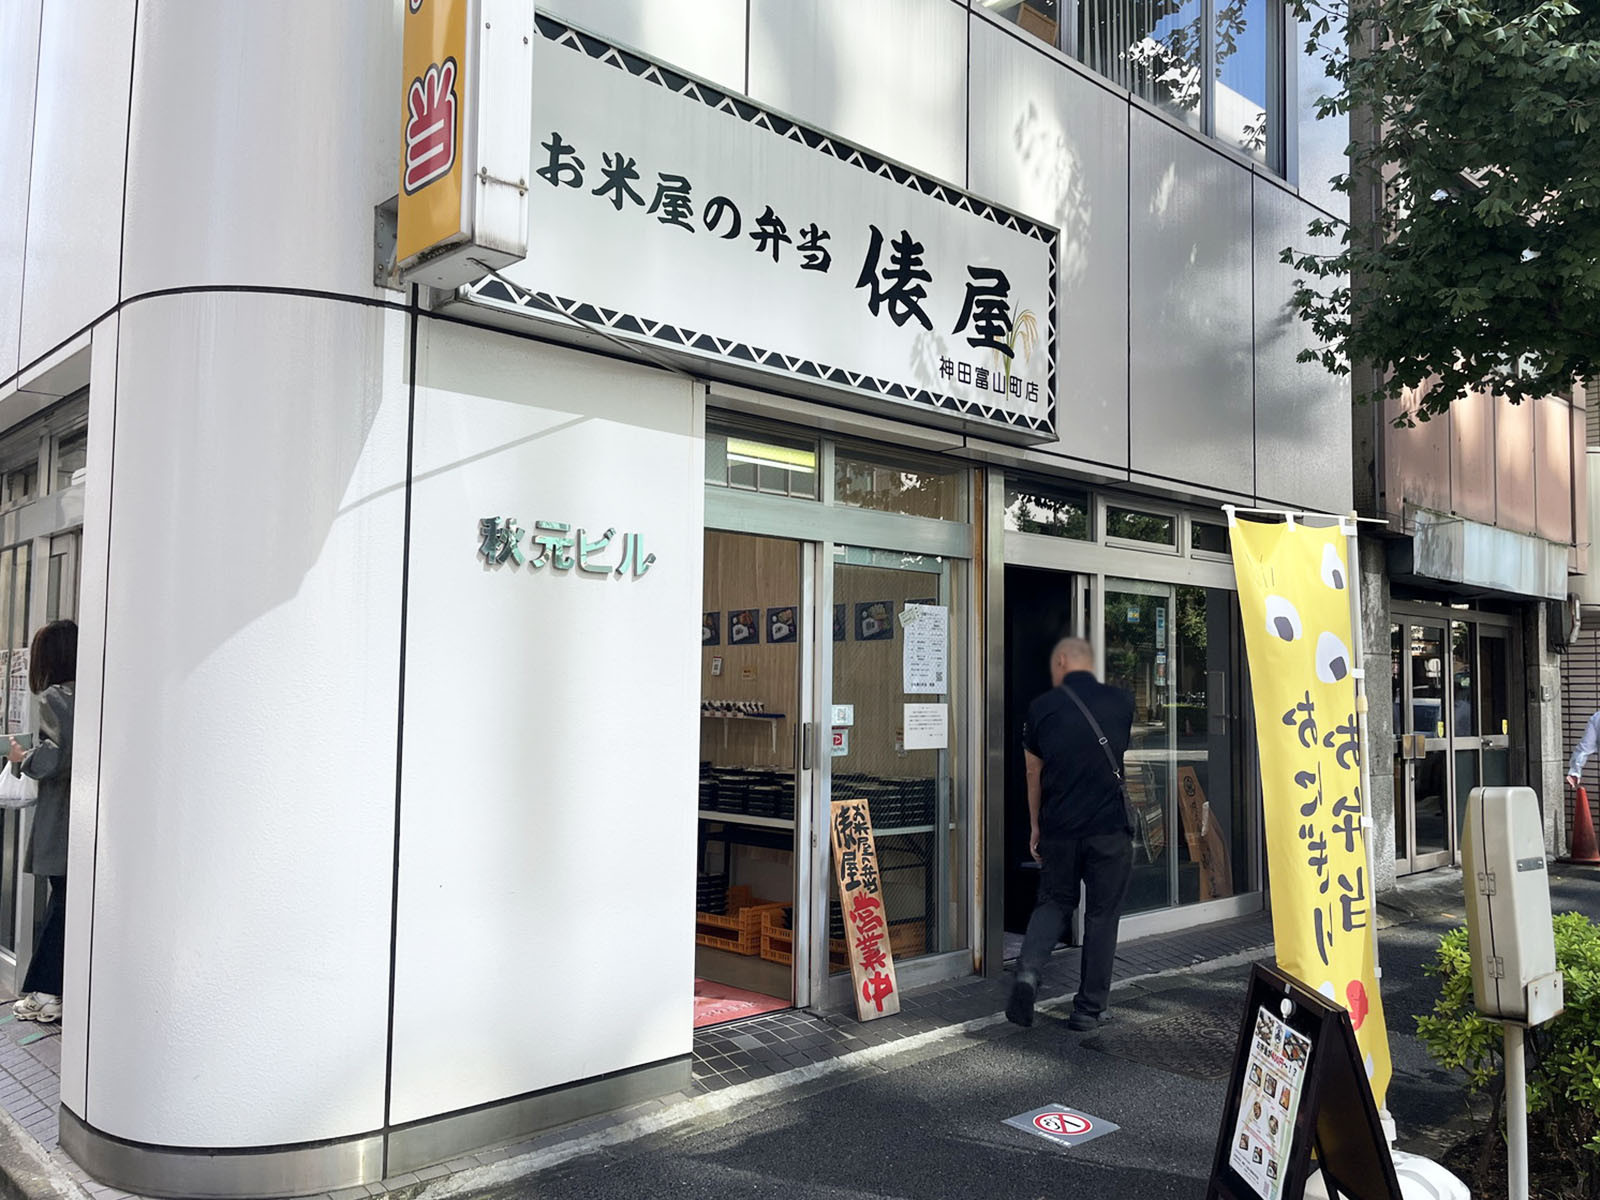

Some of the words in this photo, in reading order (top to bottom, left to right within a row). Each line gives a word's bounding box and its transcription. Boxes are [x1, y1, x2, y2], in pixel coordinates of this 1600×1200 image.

[404, 0, 457, 196] 当
[536, 132, 832, 273] お米屋の弁当
[855, 224, 1015, 359] 俵屋
[939, 355, 1039, 403] 神田富山町店
[478, 516, 657, 577] 秋元ビル
[834, 805, 862, 891] 俵屋
[850, 891, 894, 1012] 営業中
